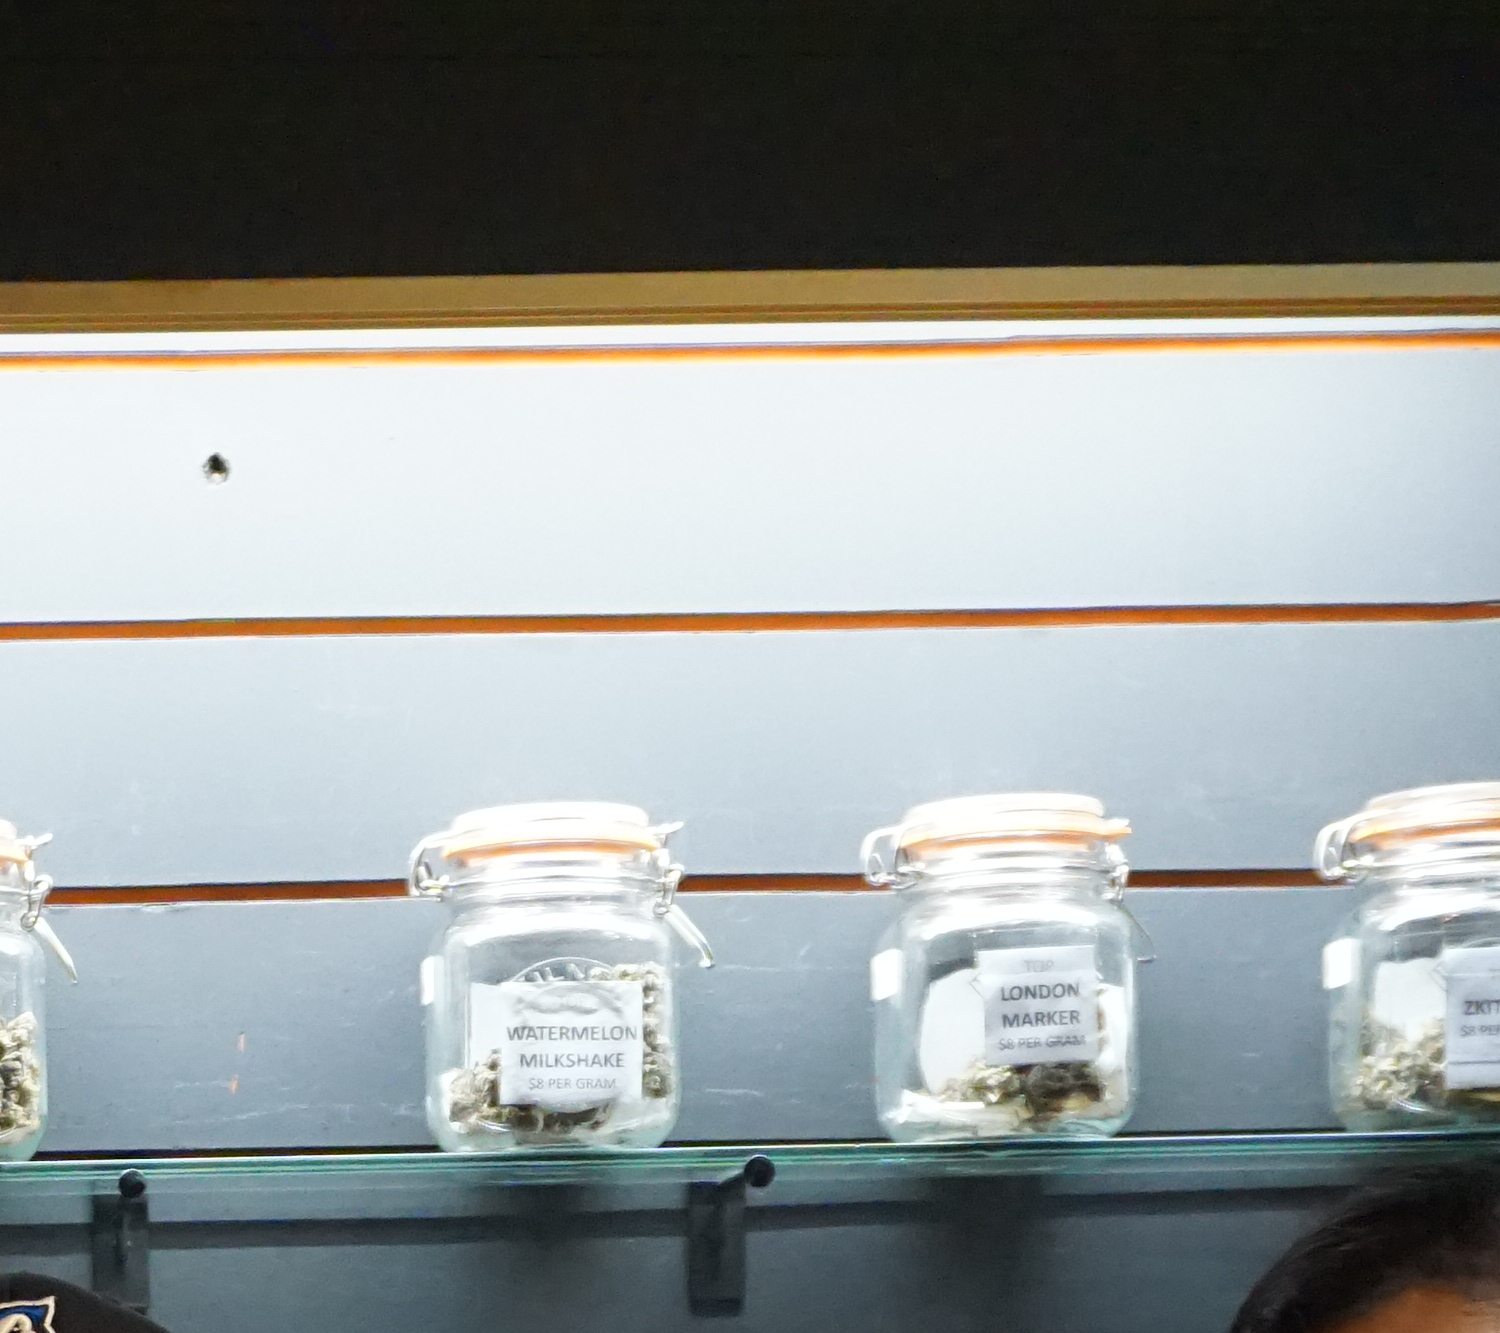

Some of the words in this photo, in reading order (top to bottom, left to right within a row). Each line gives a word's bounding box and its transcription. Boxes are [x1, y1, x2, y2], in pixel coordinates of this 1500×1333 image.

[1000, 982, 1080, 1002] LONDON
[1001, 1010, 1081, 1029] MARKER
[506, 1025, 638, 1041] WATERMELON
[1018, 1036, 1042, 1049] PER
[1045, 1034, 1087, 1048] GRAM
[519, 1052, 626, 1068] MILKSHAKE
[548, 1077, 572, 1090] PER
[576, 1077, 616, 1090] GRAM
